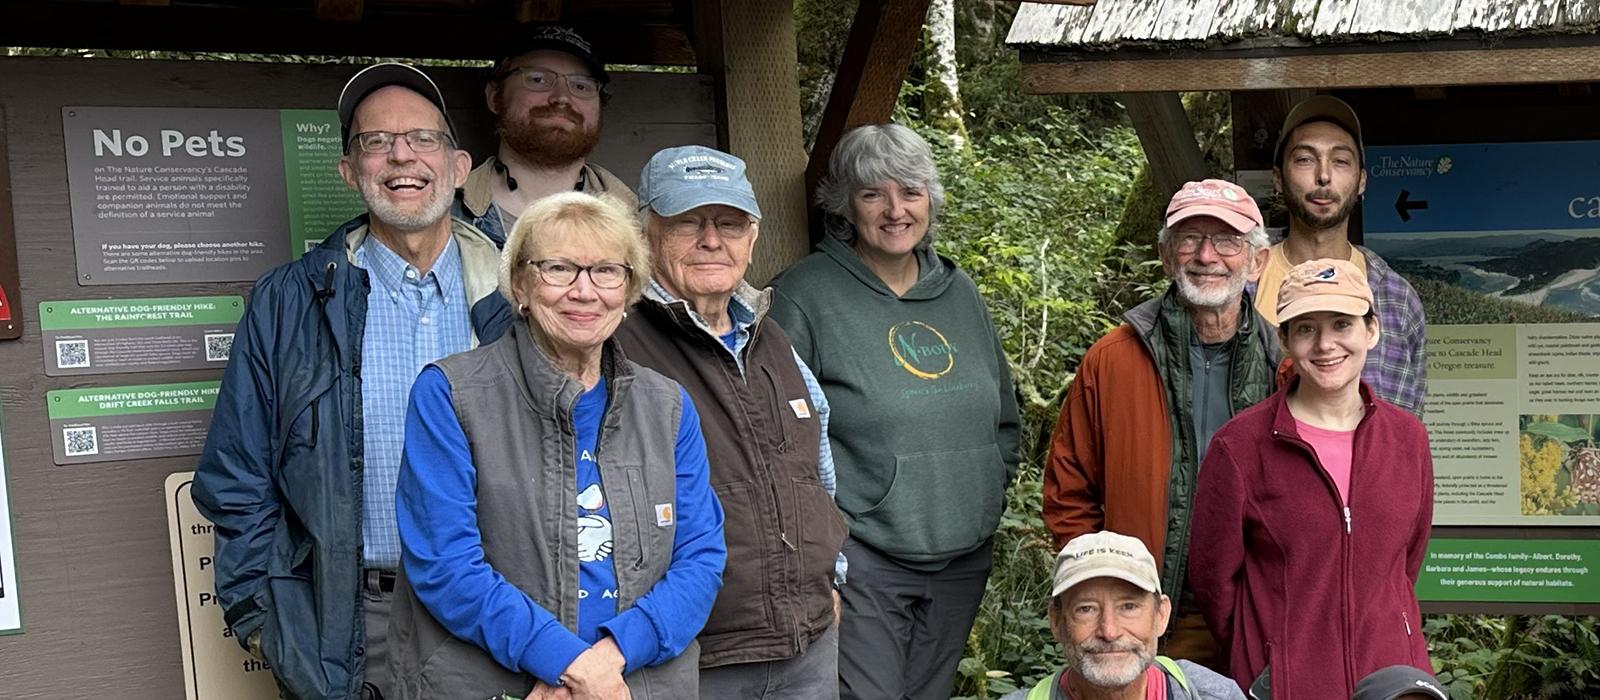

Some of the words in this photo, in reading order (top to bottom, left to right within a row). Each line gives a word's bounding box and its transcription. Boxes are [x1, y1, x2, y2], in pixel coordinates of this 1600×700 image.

[296, 124, 330, 134] Why?
[93, 130, 149, 156] No
[161, 130, 246, 157] Pets
[1380, 156, 1400, 168] The
[1401, 156, 1434, 168] Nature
[1370, 166, 1434, 178] Conservancy
[97, 202, 144, 210] companion
[70, 306, 129, 314] ALTERNATIVE
[130, 304, 192, 312] DOG-FRIENDLY
[115, 312, 168, 321] RAINFOREST
[1443, 336, 1492, 345] Conservancy
[1448, 348, 1479, 356] Cascade
[1482, 348, 1502, 356] Head
[1433, 362, 1462, 371] Oregon
[78, 392, 136, 403] ALTERNATIVE
[137, 389, 199, 399] DOG-FRIENDLY
[100, 400, 125, 409] DRIFT
[127, 399, 152, 407] CREEK
[154, 398, 179, 406] FALLS
[180, 396, 204, 404] TRAIL
[1076, 548, 1094, 558] LIFE
[1513, 566, 1534, 574] legacy
[1562, 566, 1588, 575] through
[1487, 579, 1512, 587] support
[200, 592, 217, 606] Pr
[578, 590, 588, 600] D
